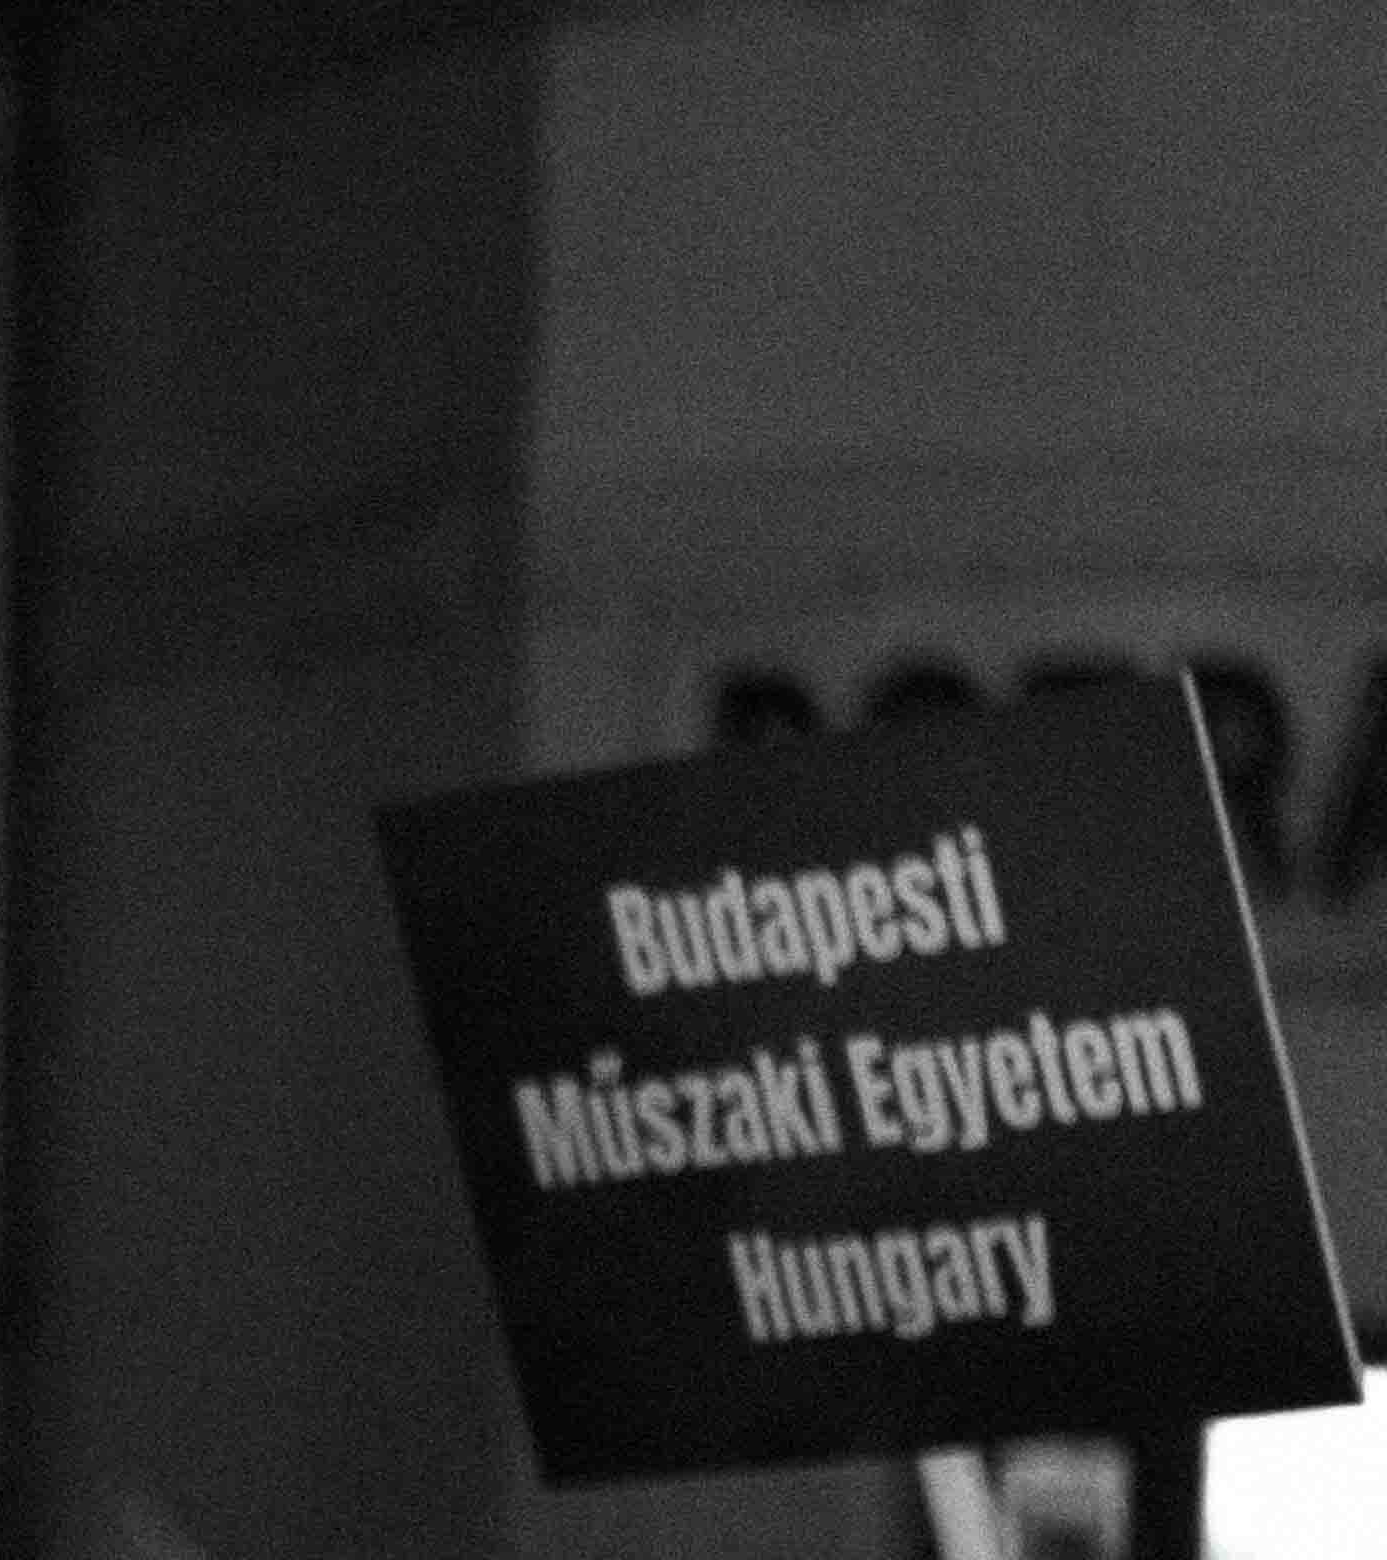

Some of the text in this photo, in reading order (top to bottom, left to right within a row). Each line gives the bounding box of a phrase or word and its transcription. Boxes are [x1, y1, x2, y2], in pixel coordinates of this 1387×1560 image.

[608, 825, 1007, 995] Budapesti
[844, 1007, 1203, 1153] Egyetem
[730, 1216, 1053, 1340] Hungary
